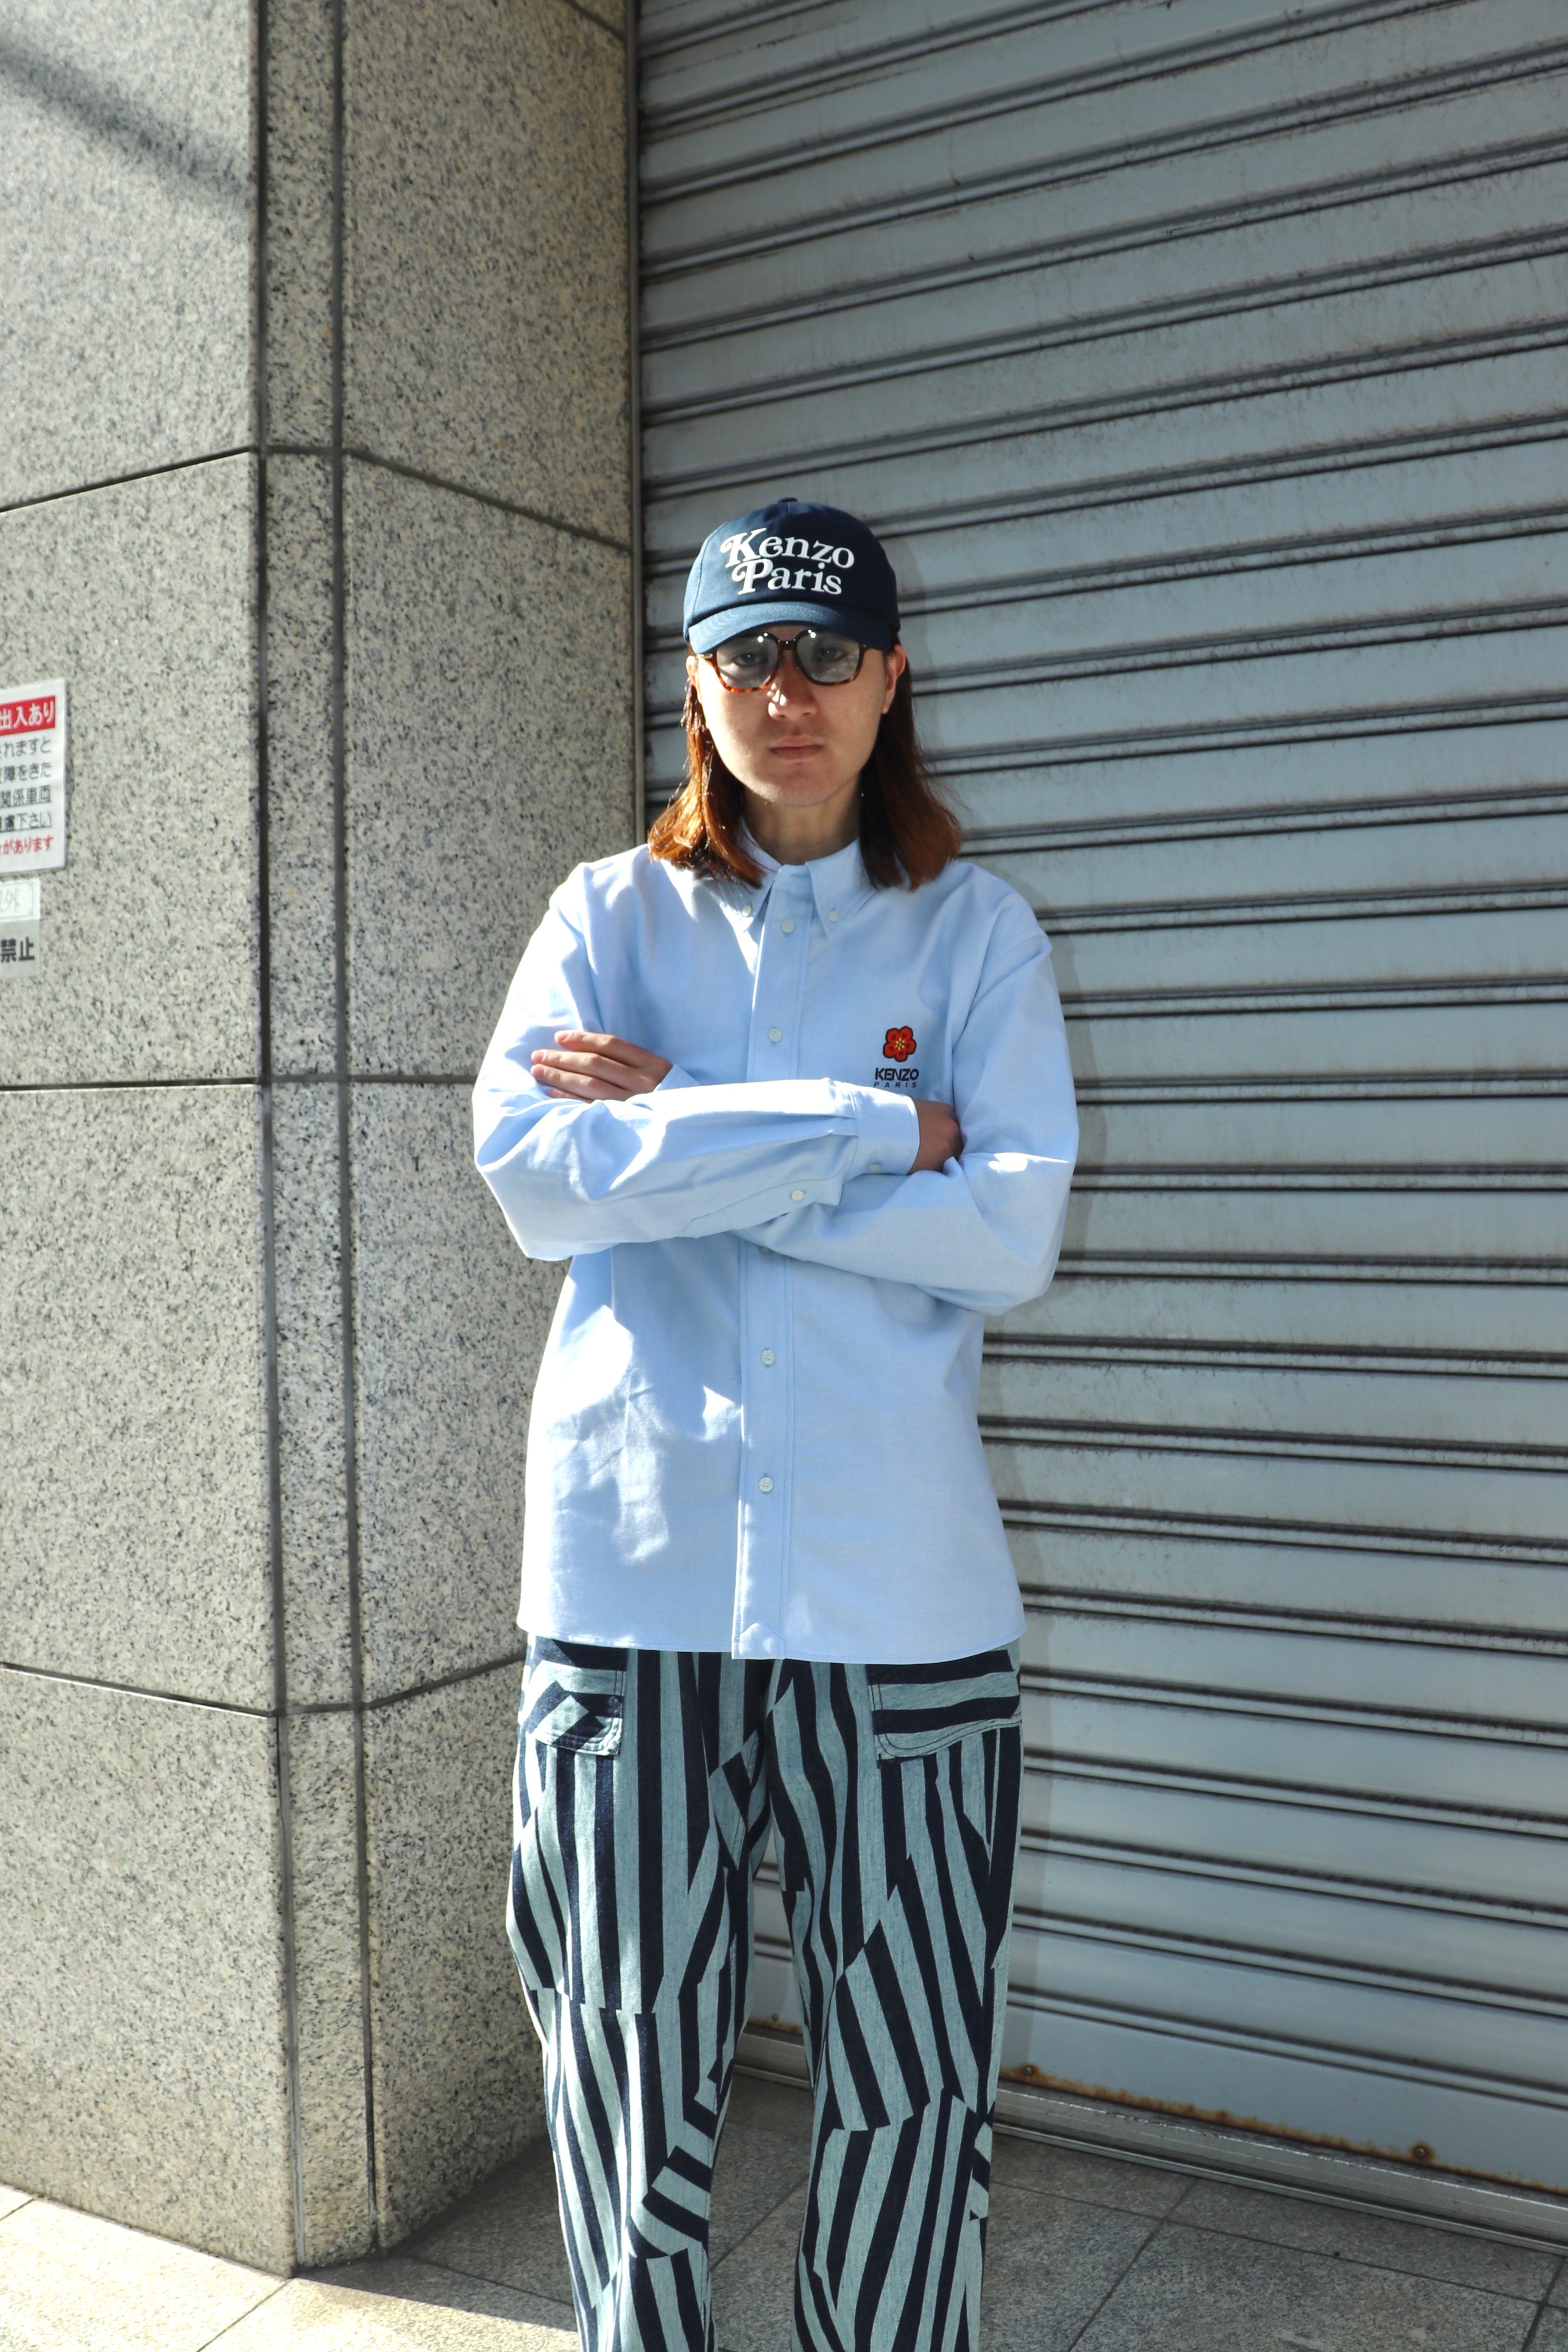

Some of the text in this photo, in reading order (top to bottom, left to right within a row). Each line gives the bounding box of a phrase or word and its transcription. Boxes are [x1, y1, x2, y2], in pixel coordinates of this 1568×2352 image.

[720, 528, 855, 569] Kenzo
[732, 558, 842, 595] Paris
[0, 736, 51, 758] れますと
[0, 761, 51, 783] 障をきた
[0, 811, 51, 832] 慮下さい
[0, 835, 53, 856] があります
[0, 936, 35, 962] 禁止
[875, 1068, 919, 1081] KENZO
